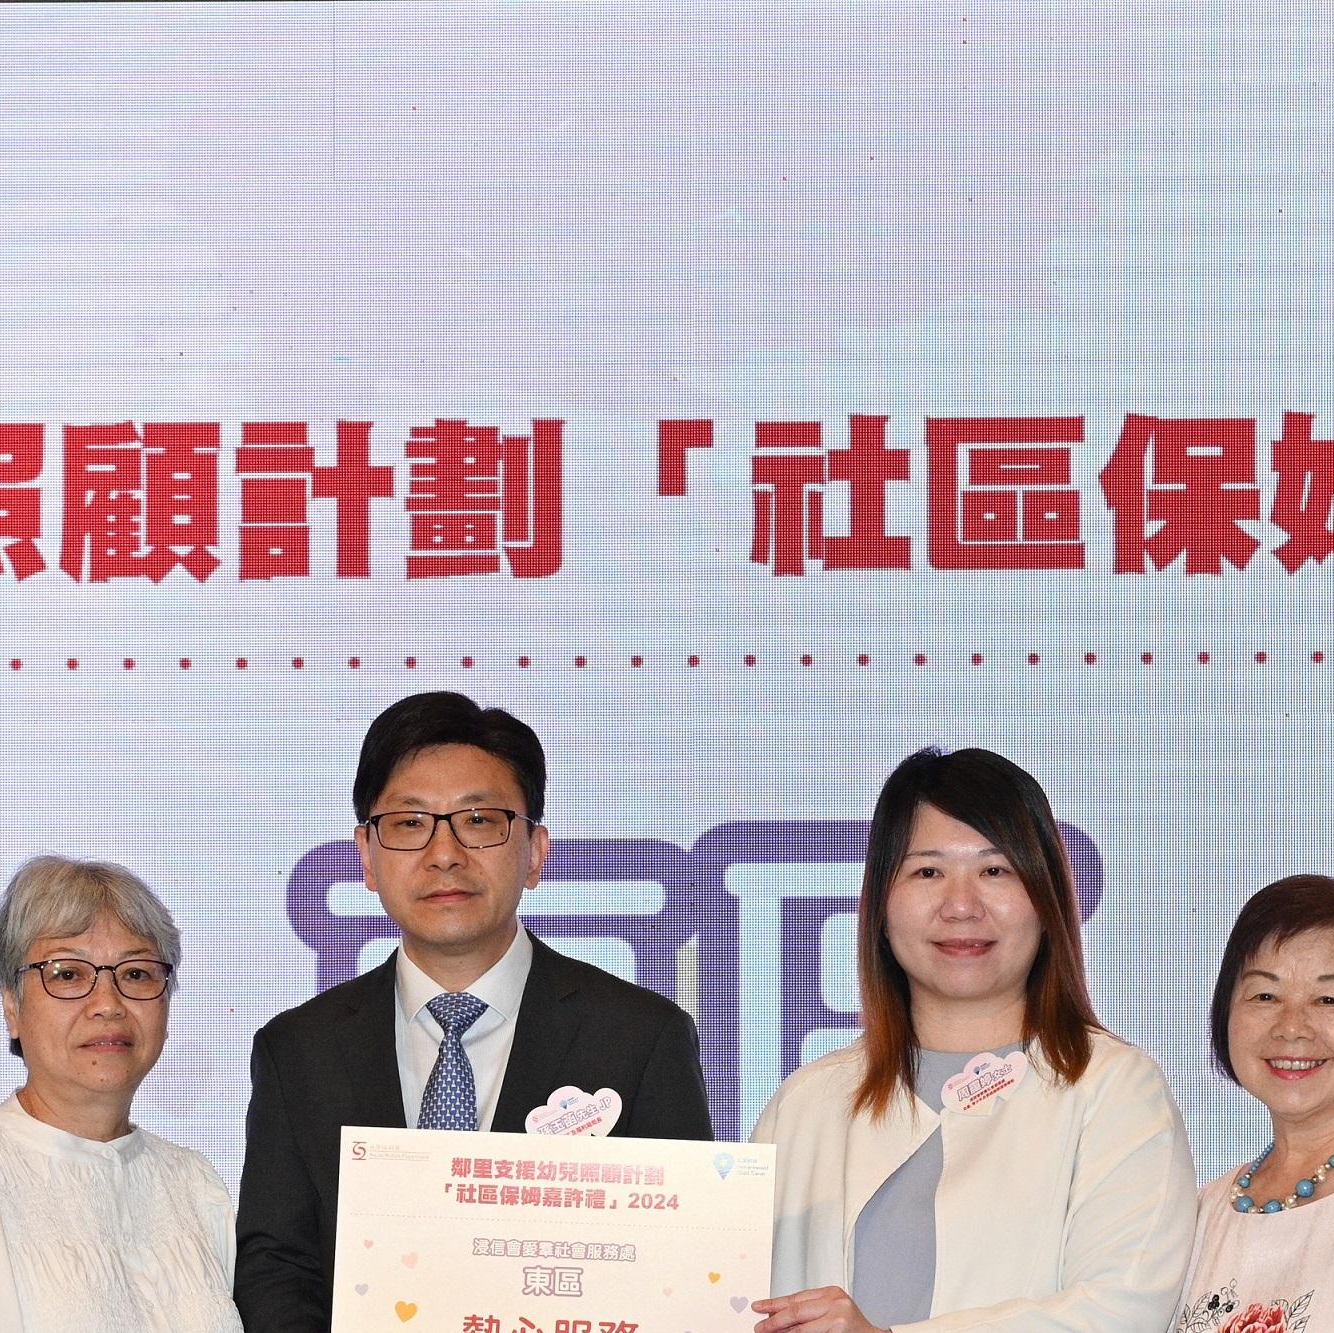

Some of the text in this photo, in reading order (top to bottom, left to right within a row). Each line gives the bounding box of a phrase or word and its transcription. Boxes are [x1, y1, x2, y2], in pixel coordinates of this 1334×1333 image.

[451, 1157, 665, 1186] 鄰里支援幼兒照顧計劃
[628, 1192, 680, 1211] 2024
[522, 1264, 584, 1297] 東區
